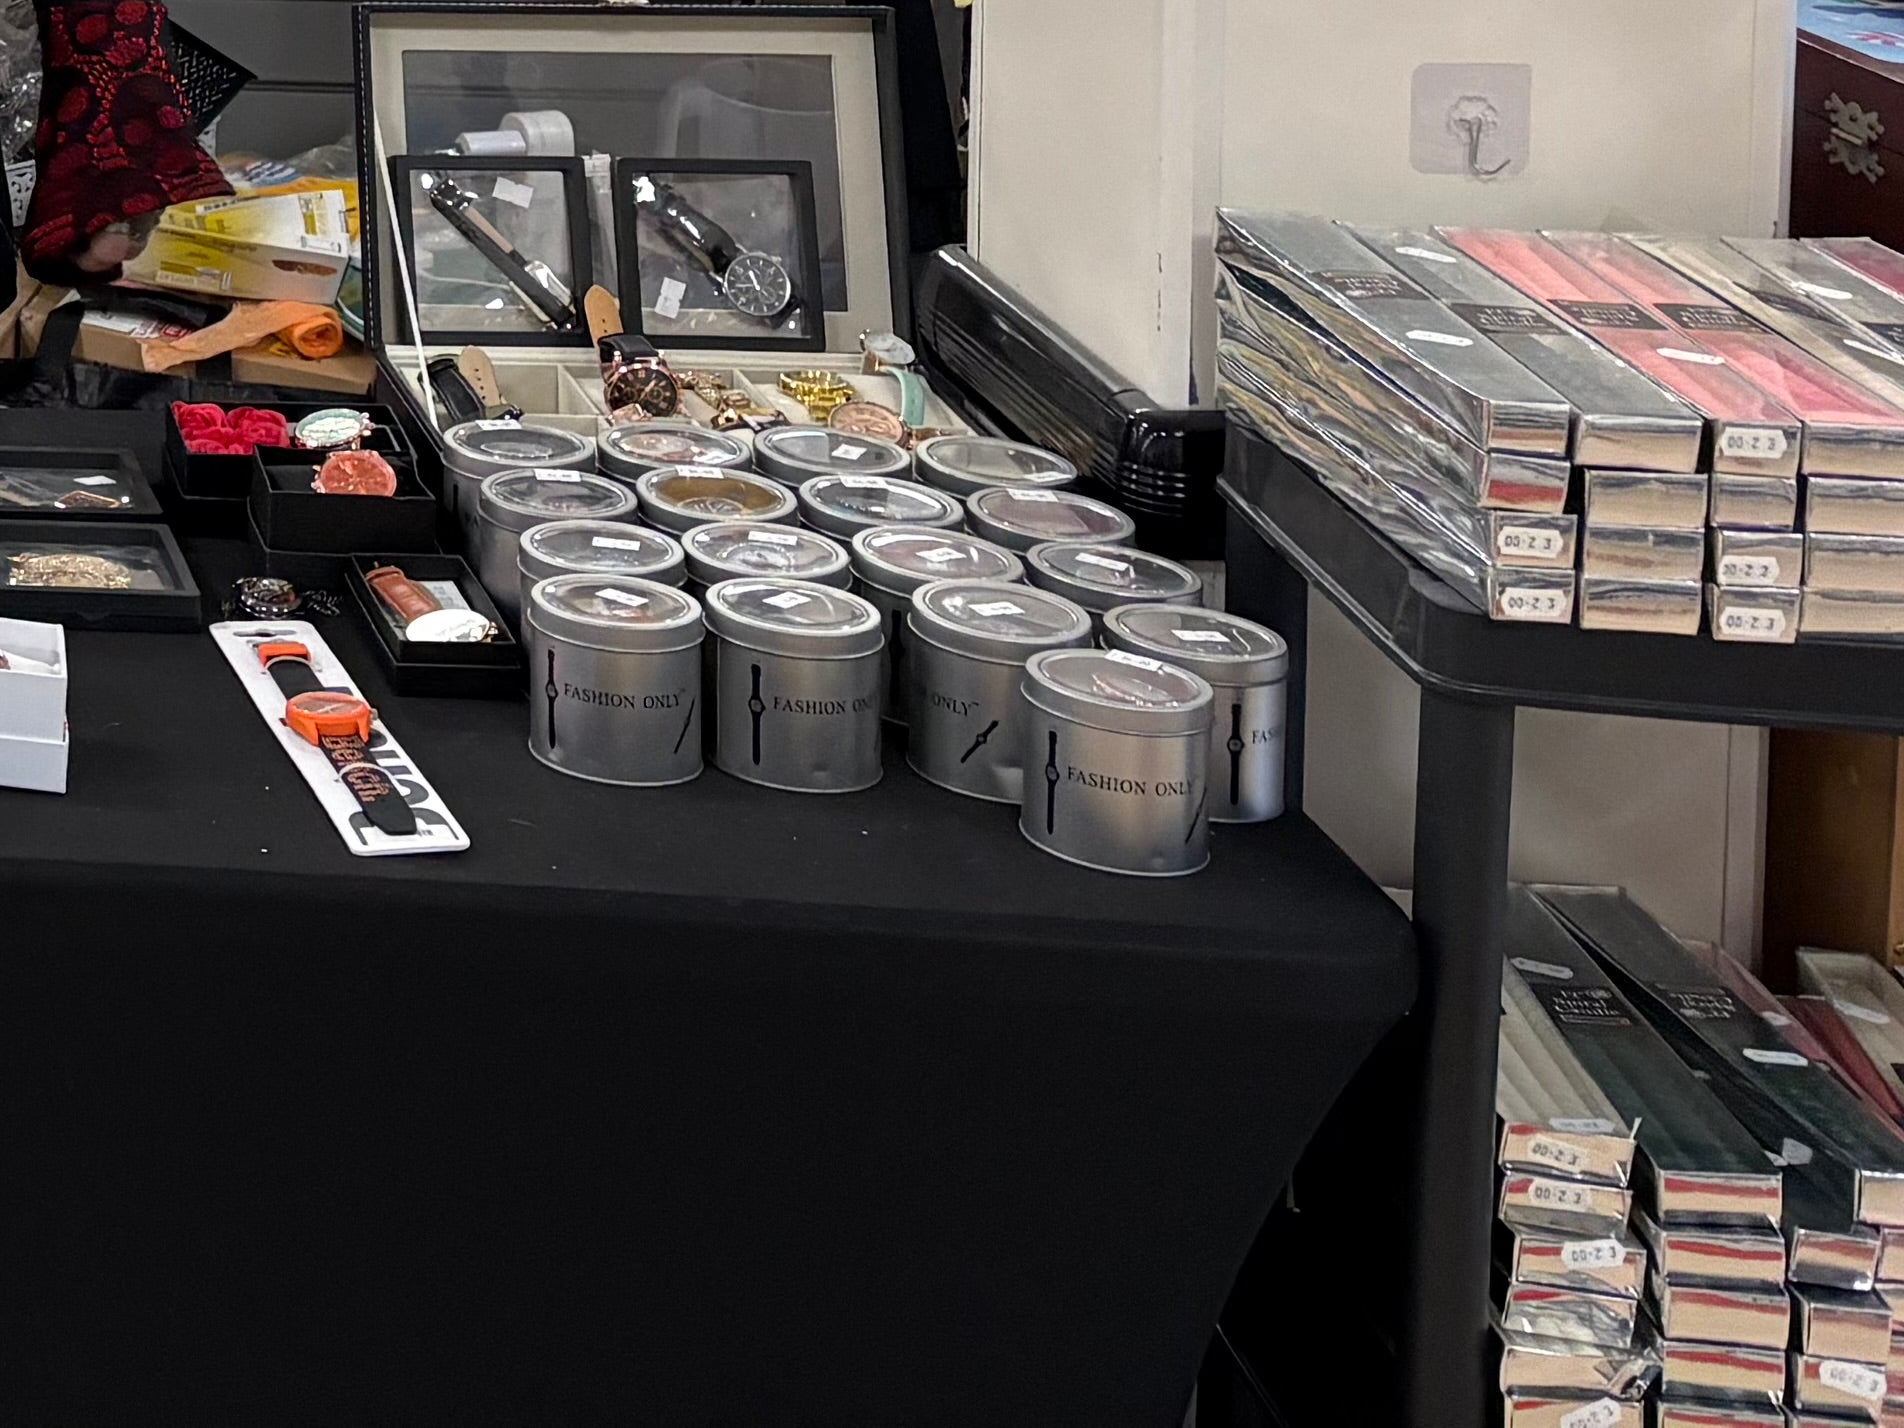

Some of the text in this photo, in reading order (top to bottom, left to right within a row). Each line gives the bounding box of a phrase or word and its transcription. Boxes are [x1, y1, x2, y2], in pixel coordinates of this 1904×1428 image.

[564, 683, 636, 709] FASHION
[773, 696, 847, 716] FASHION
[1067, 765, 1148, 797] FASHION
